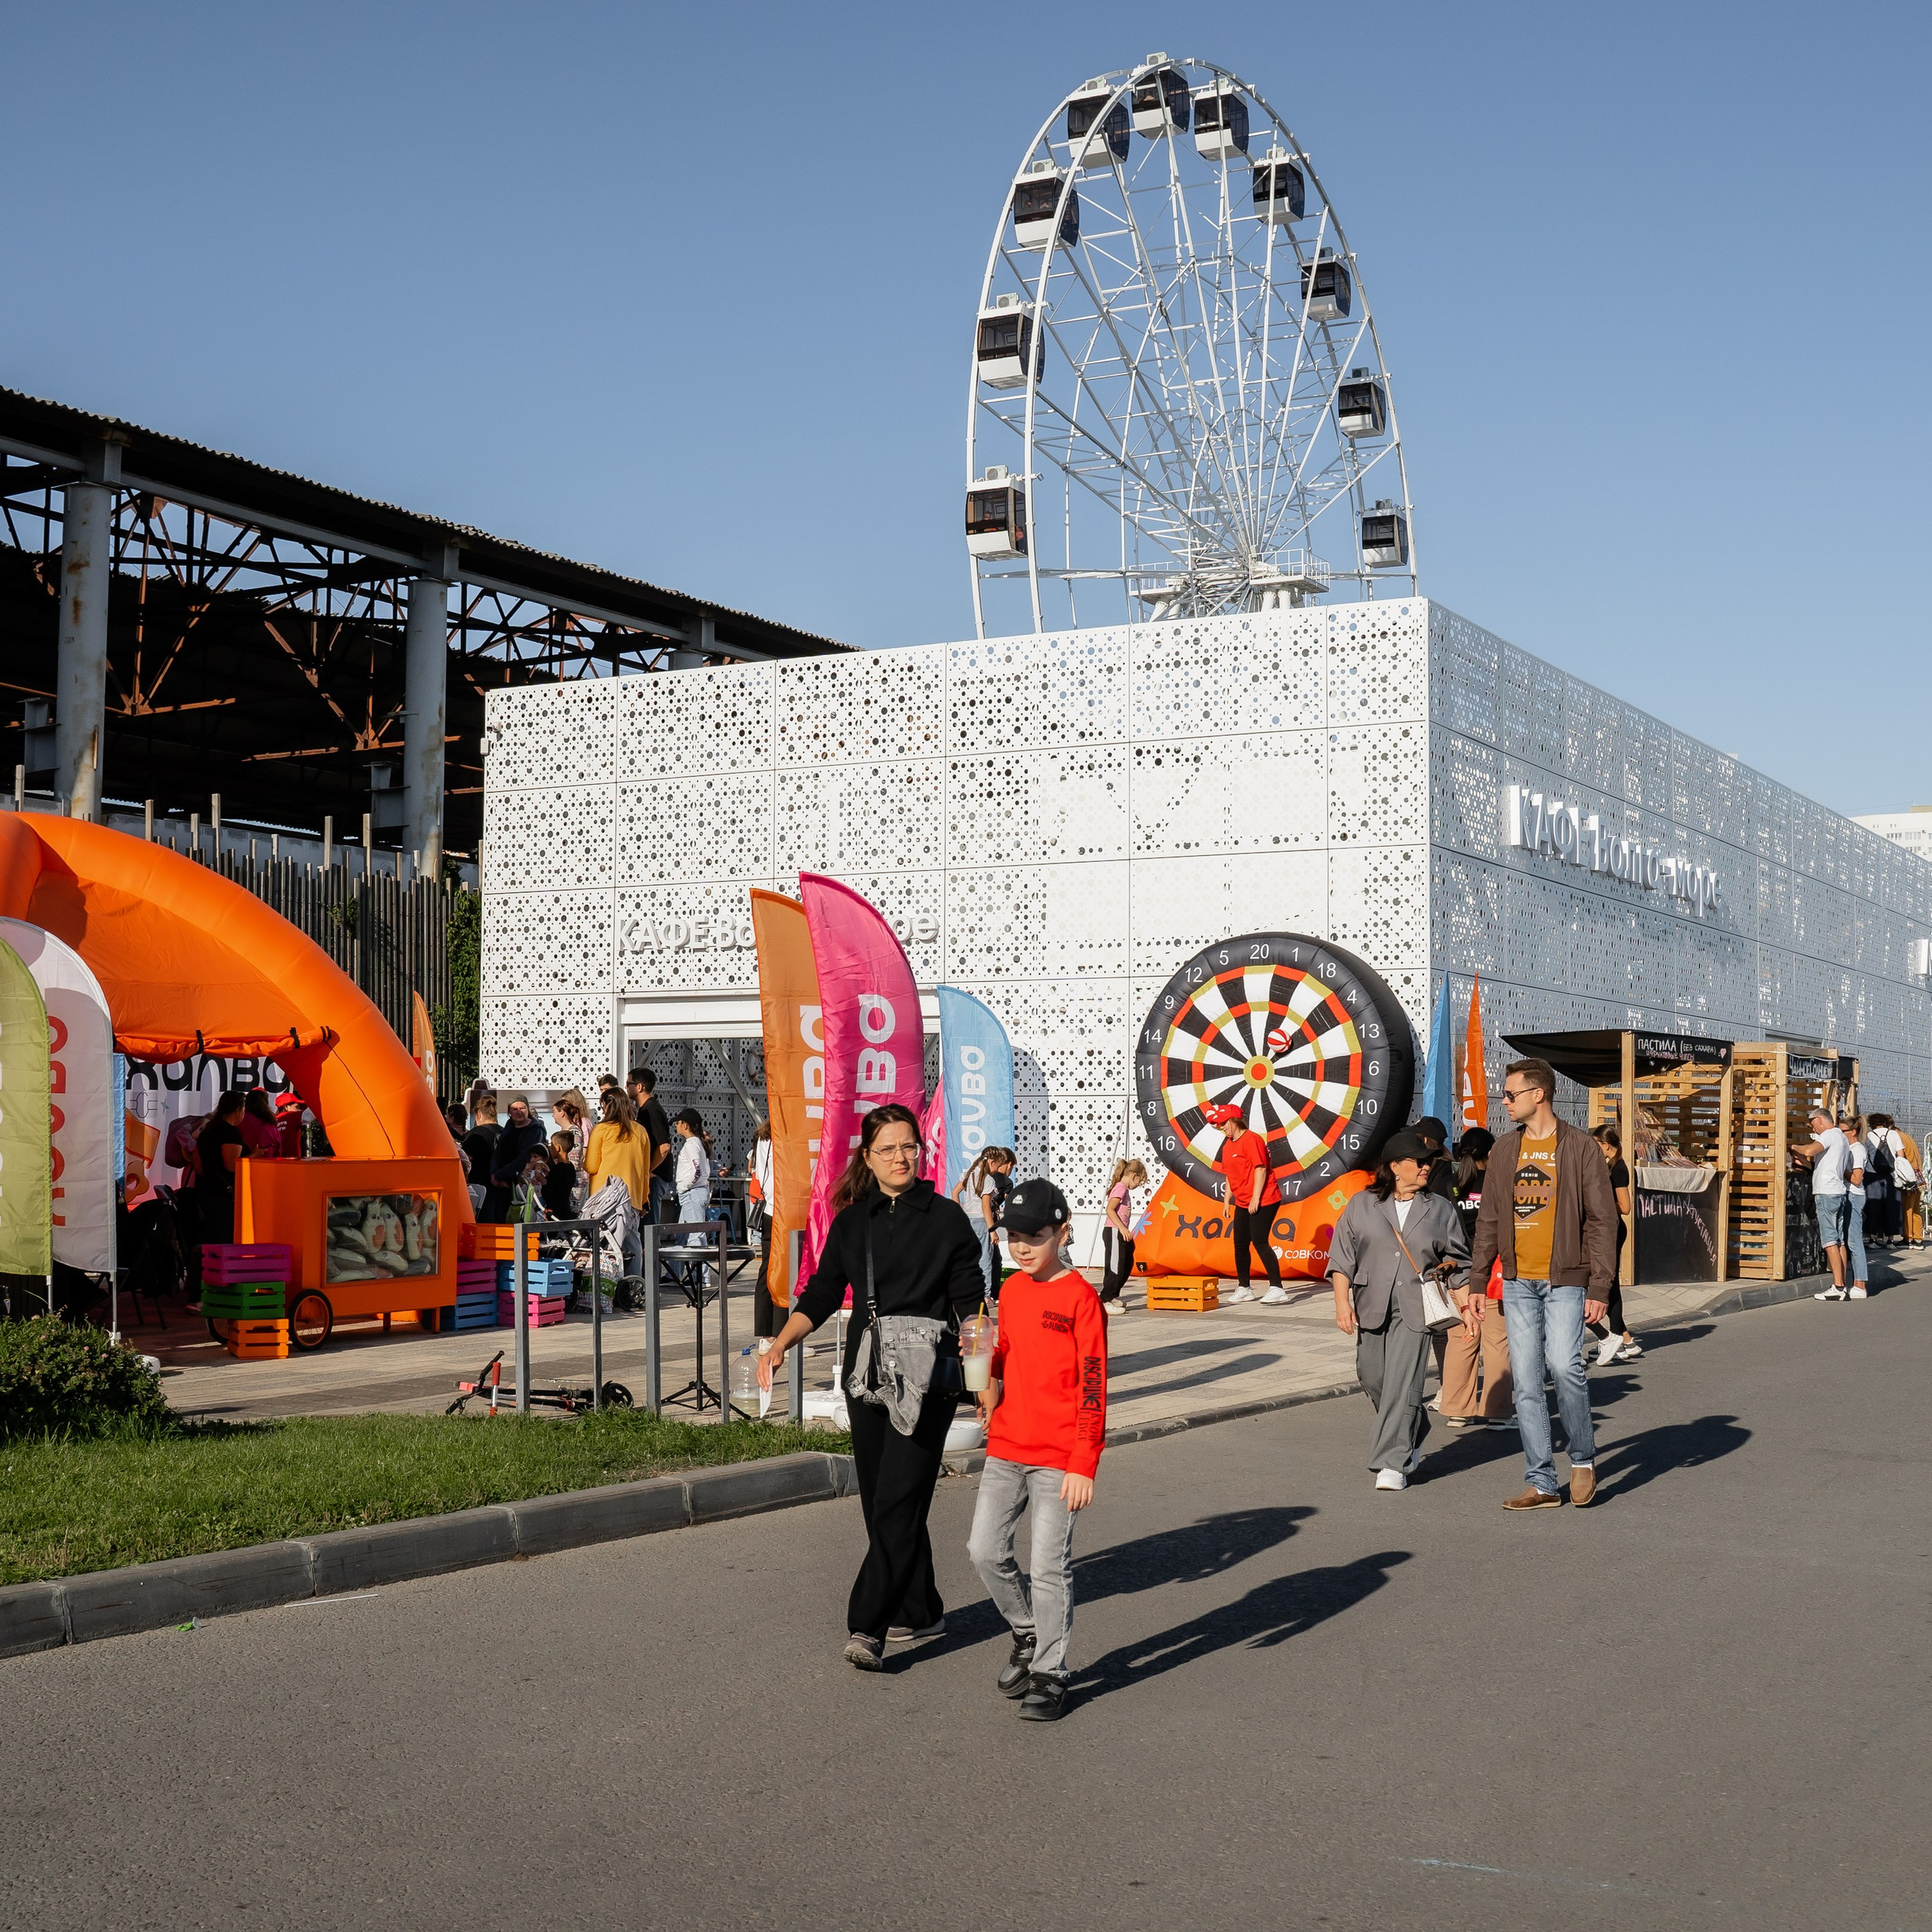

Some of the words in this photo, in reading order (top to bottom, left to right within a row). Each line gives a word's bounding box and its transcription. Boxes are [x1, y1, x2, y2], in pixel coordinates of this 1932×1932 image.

[1510, 785, 1590, 867] КАФЕ
[617, 915, 709, 952] КАФЕ
[1219, 950, 1229, 965] 5
[1250, 944, 1269, 959] 20
[1292, 947, 1299, 961] 1
[1185, 968, 1203, 983] 12
[1318, 963, 1337, 978] 18
[1164, 995, 1174, 1010] 9
[1347, 989, 1357, 1004] 4
[1144, 1029, 1162, 1043] 14
[1358, 1023, 1380, 1038] 13
[1638, 1039, 1676, 1051] ПАСТИЛА
[1139, 1065, 1153, 1079] 11
[1368, 1061, 1379, 1075] 6
[1147, 1101, 1156, 1115] 8
[1358, 1100, 1377, 1115] 10
[1158, 1136, 1176, 1151] 16
[1340, 1134, 1360, 1149] 15
[1530, 1152, 1549, 1160] JNS
[1184, 1163, 1195, 1177] 7
[1320, 1161, 1331, 1177] 2
[1283, 1180, 1302, 1196] 17
[1514, 1179, 1552, 1204] ORE
